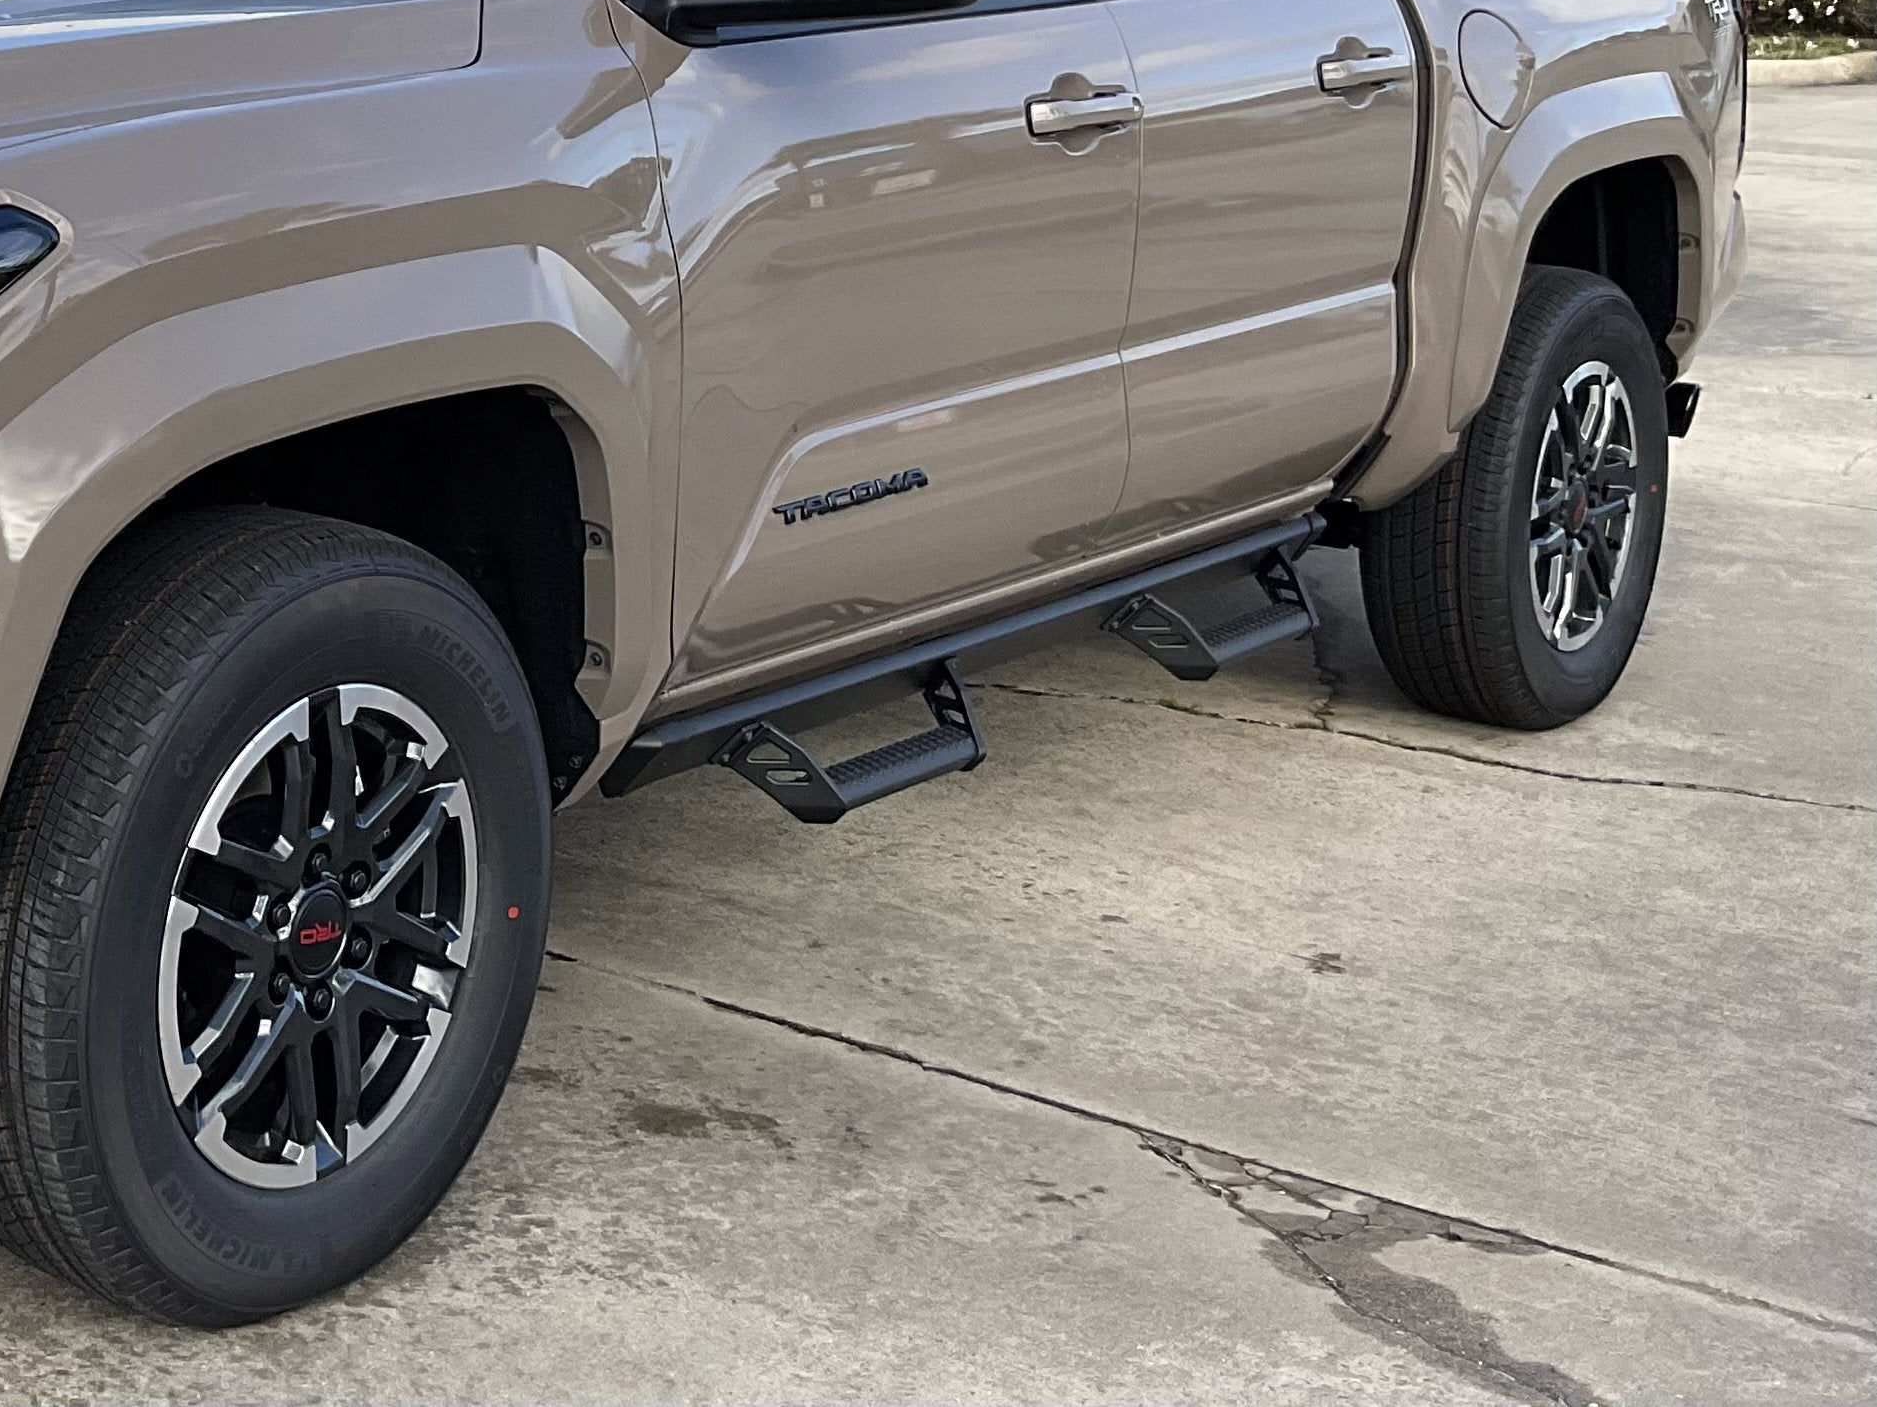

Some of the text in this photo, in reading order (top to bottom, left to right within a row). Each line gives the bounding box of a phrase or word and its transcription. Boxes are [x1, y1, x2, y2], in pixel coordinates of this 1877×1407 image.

[772, 467, 929, 525] TACOMA
[419, 624, 512, 724] MICHELIN
[300, 920, 342, 945] TRD
[161, 1180, 279, 1271] MICHELIN
